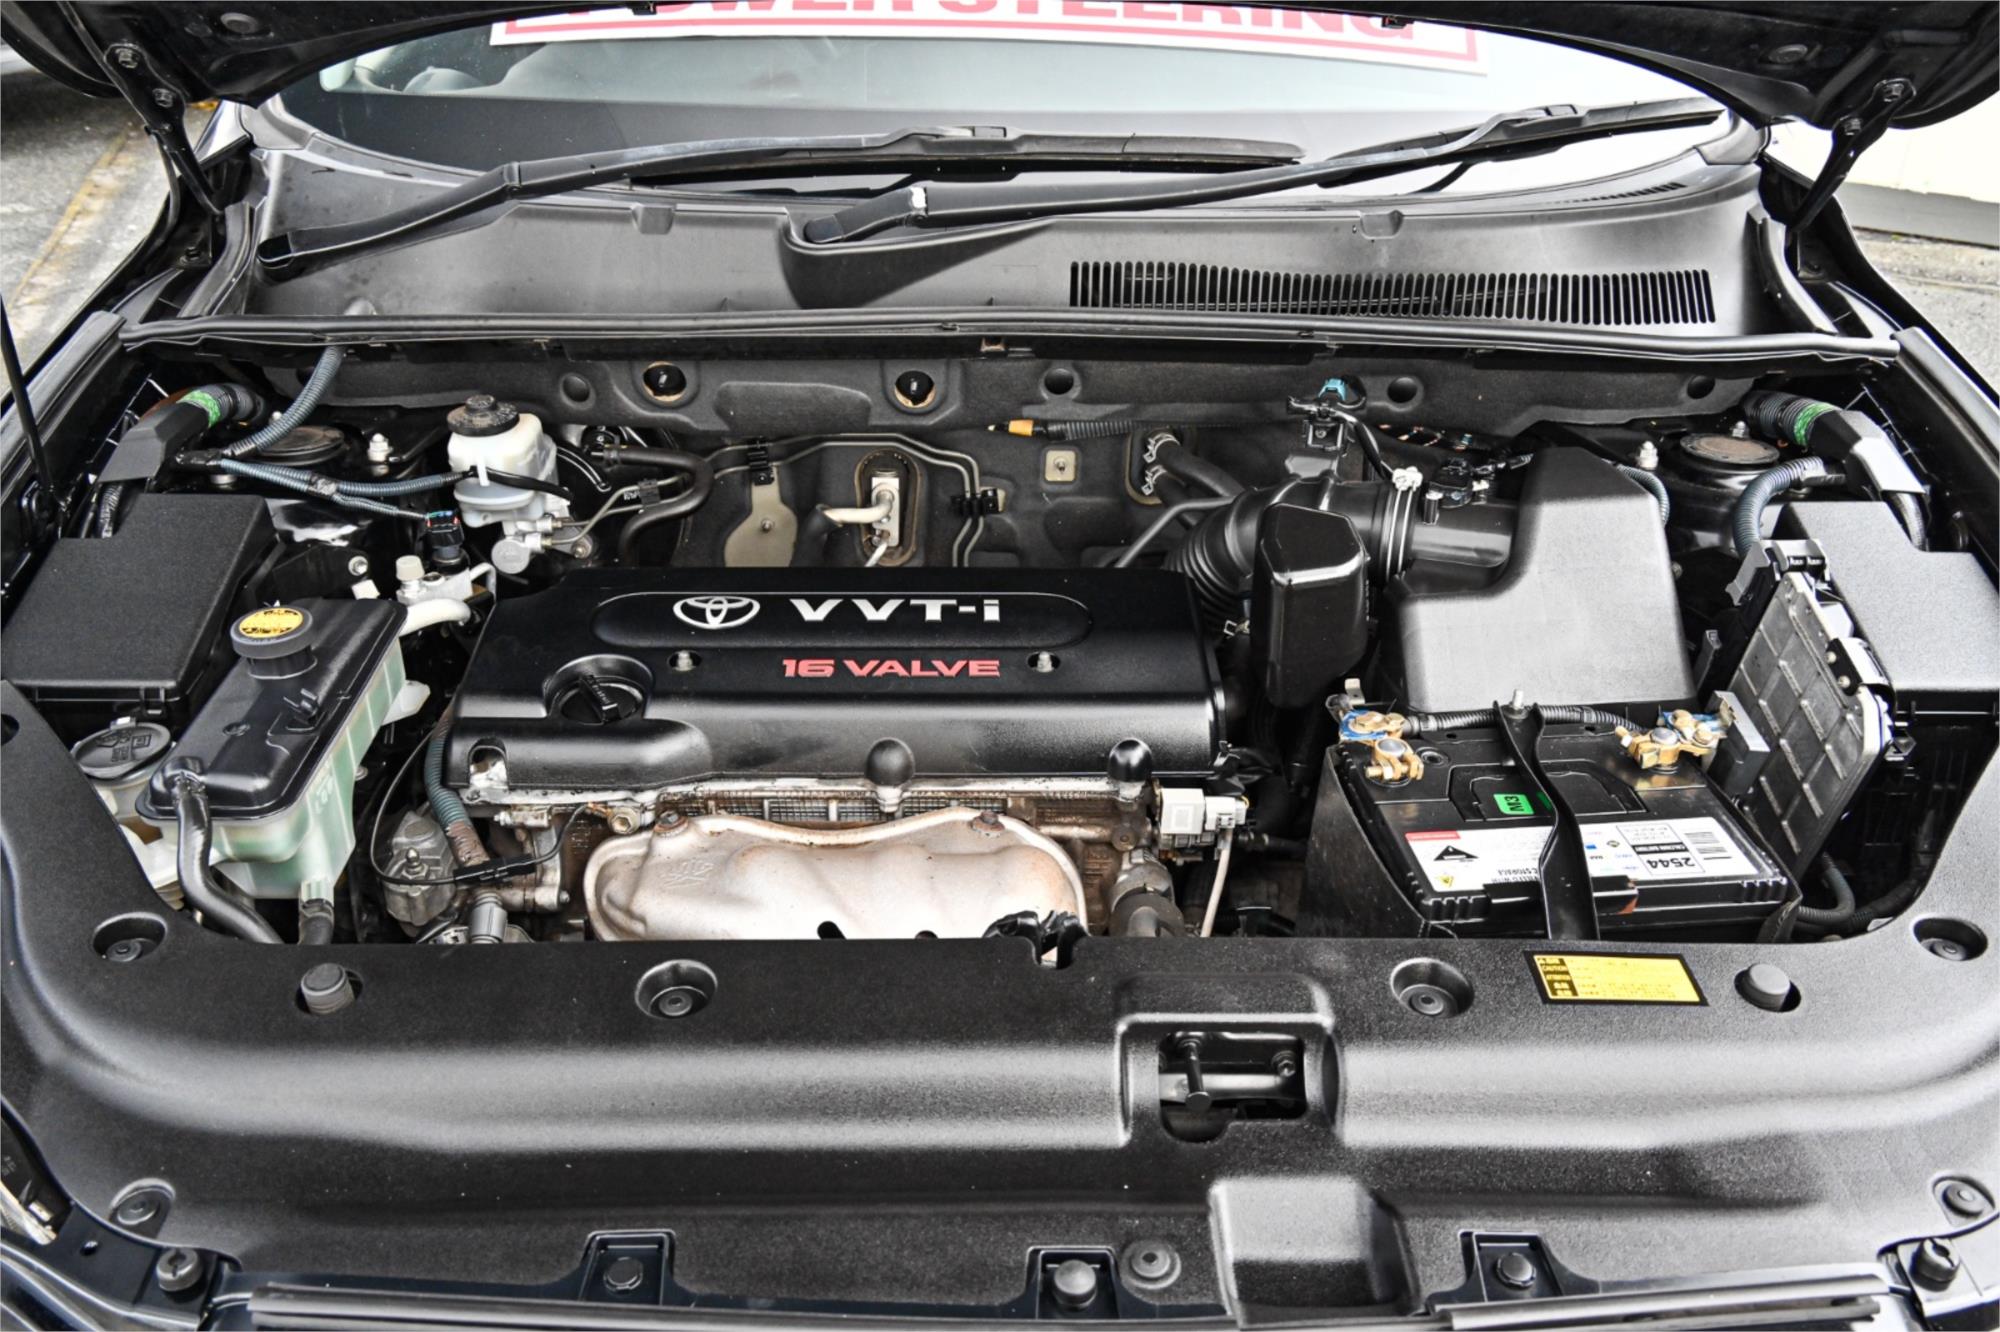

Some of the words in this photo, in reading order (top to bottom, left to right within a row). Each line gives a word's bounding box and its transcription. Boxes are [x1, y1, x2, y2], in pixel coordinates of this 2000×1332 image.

[789, 598, 1000, 621] VVT-i
[782, 658, 835, 677] 16
[843, 658, 1000, 677] VALVE
[1647, 857, 1695, 869] 2544
